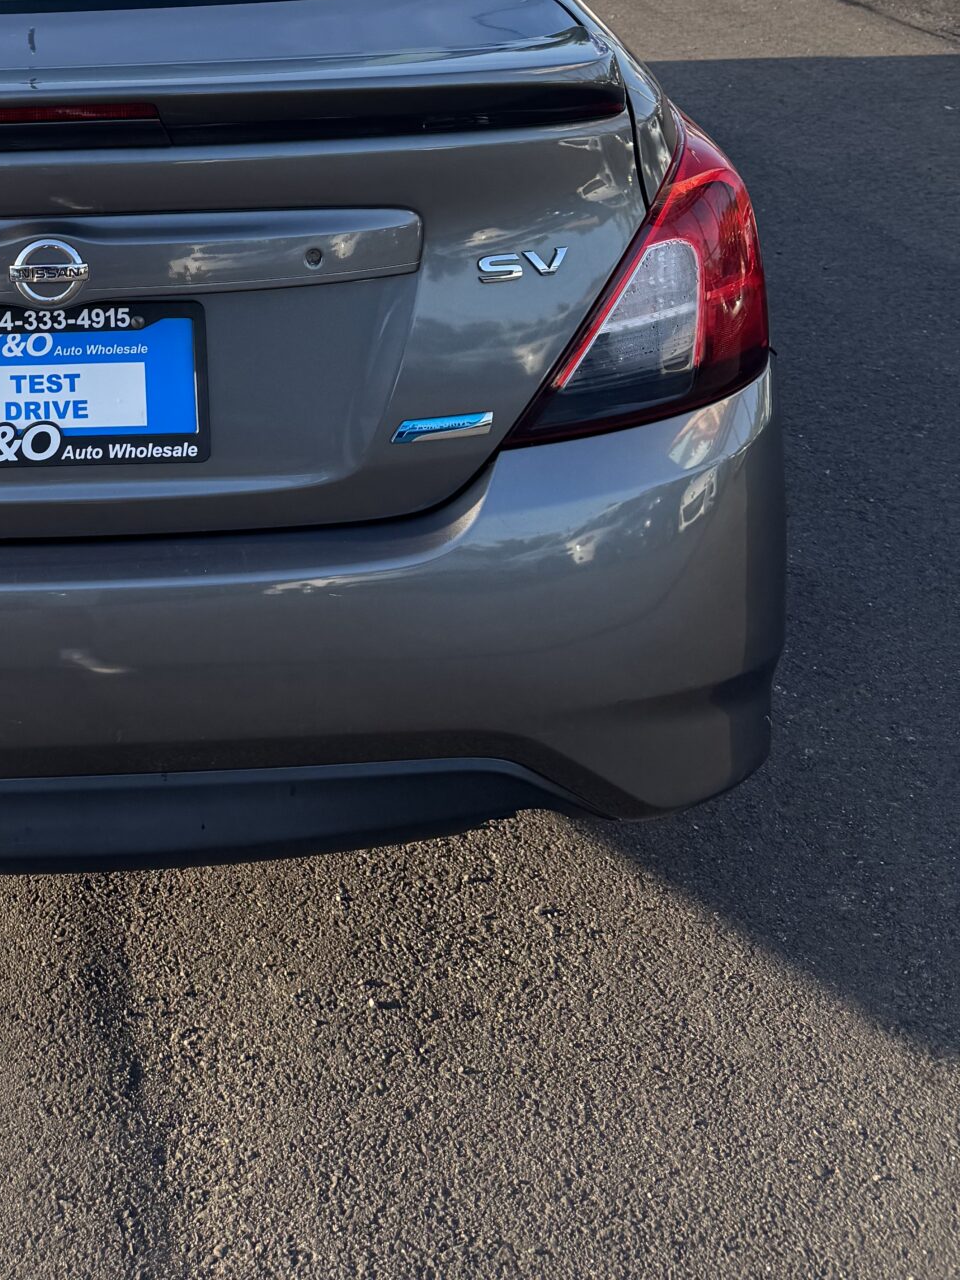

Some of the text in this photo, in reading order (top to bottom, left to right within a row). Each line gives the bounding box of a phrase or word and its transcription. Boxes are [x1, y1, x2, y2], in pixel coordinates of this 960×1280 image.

[19, 267, 80, 279] NISSAN
[477, 246, 568, 283] SV
[54, 346, 82, 356] Auto
[86, 343, 148, 355] Wholesale
[10, 373, 80, 394] TEST
[5, 400, 89, 420] DRIVE
[61, 445, 103, 460] Auto
[108, 442, 198, 459] Wholesale
